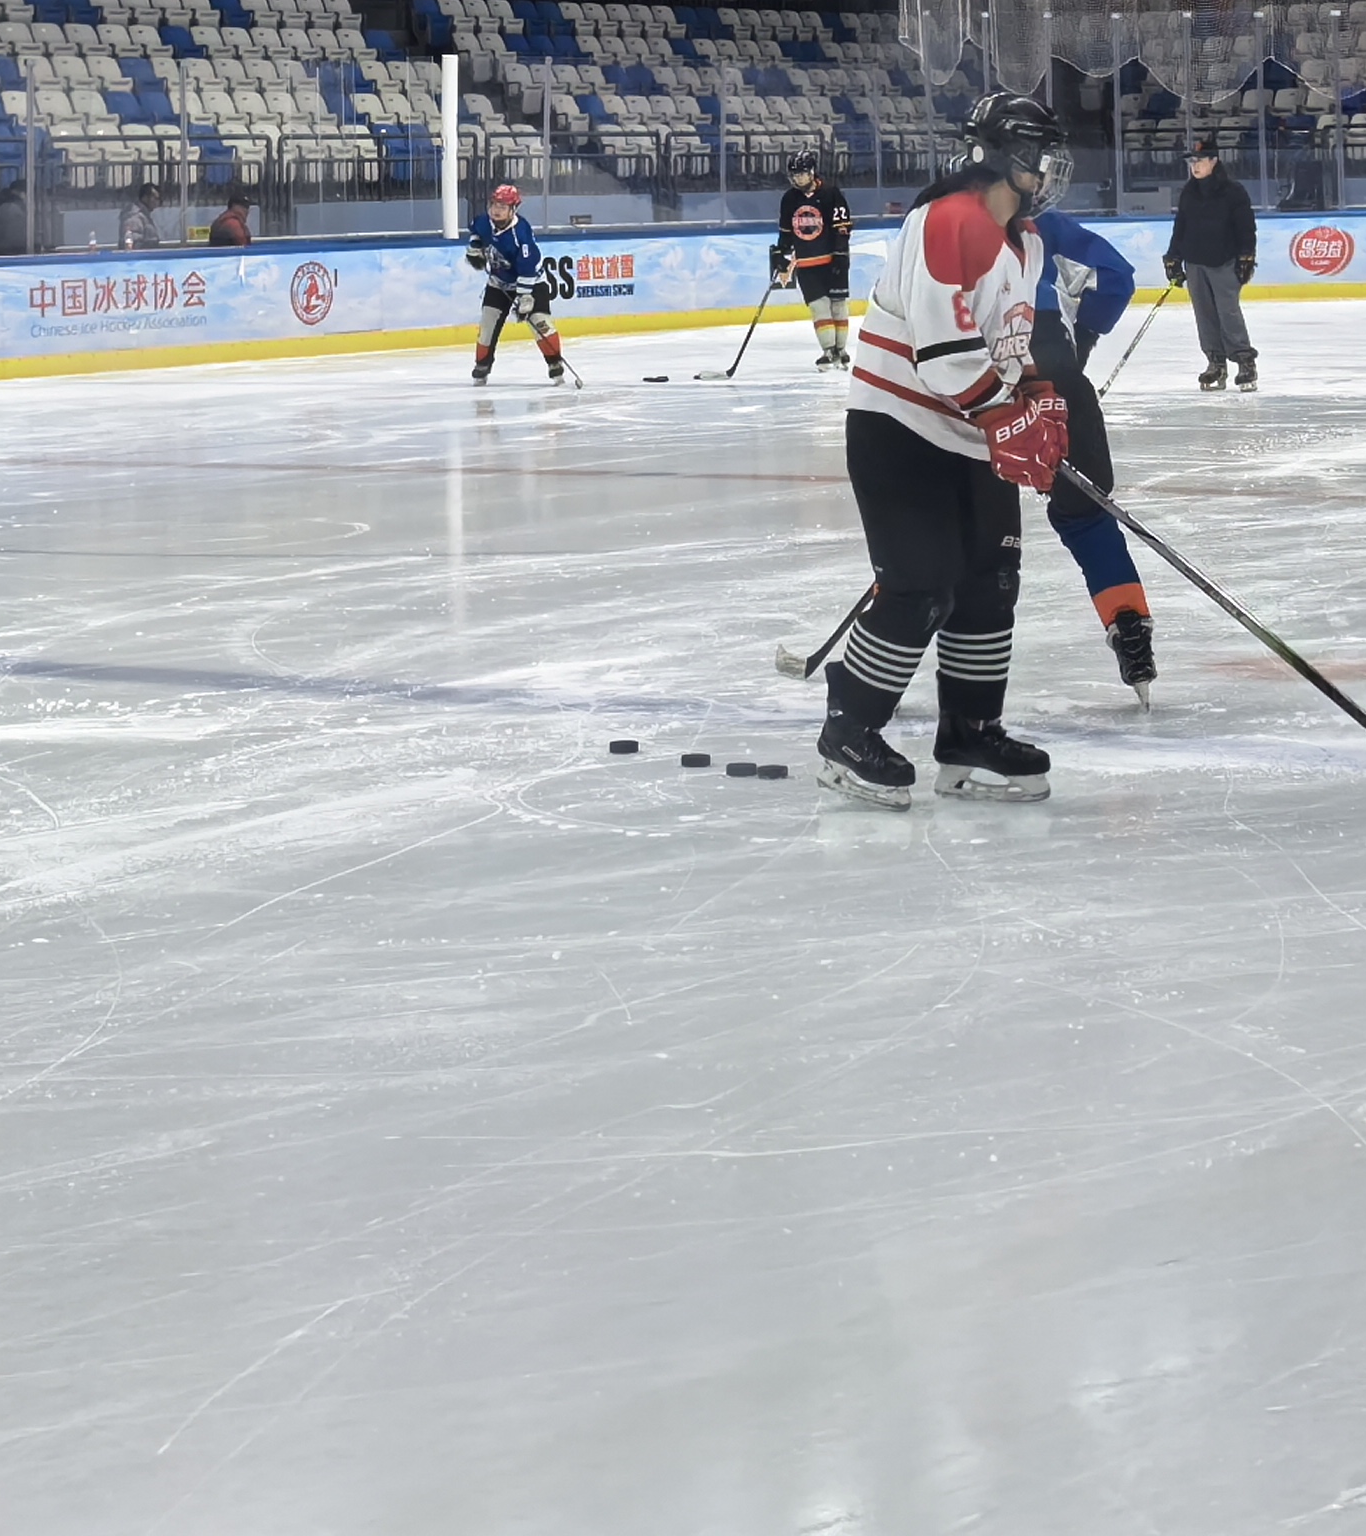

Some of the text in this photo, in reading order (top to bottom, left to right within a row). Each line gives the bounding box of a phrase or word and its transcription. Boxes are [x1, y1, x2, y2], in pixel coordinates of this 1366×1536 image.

[832, 207, 848, 221] 22
[29, 270, 207, 318] 中国冰球协会
[30, 323, 78, 339] Chinese
[144, 314, 208, 331] Association
